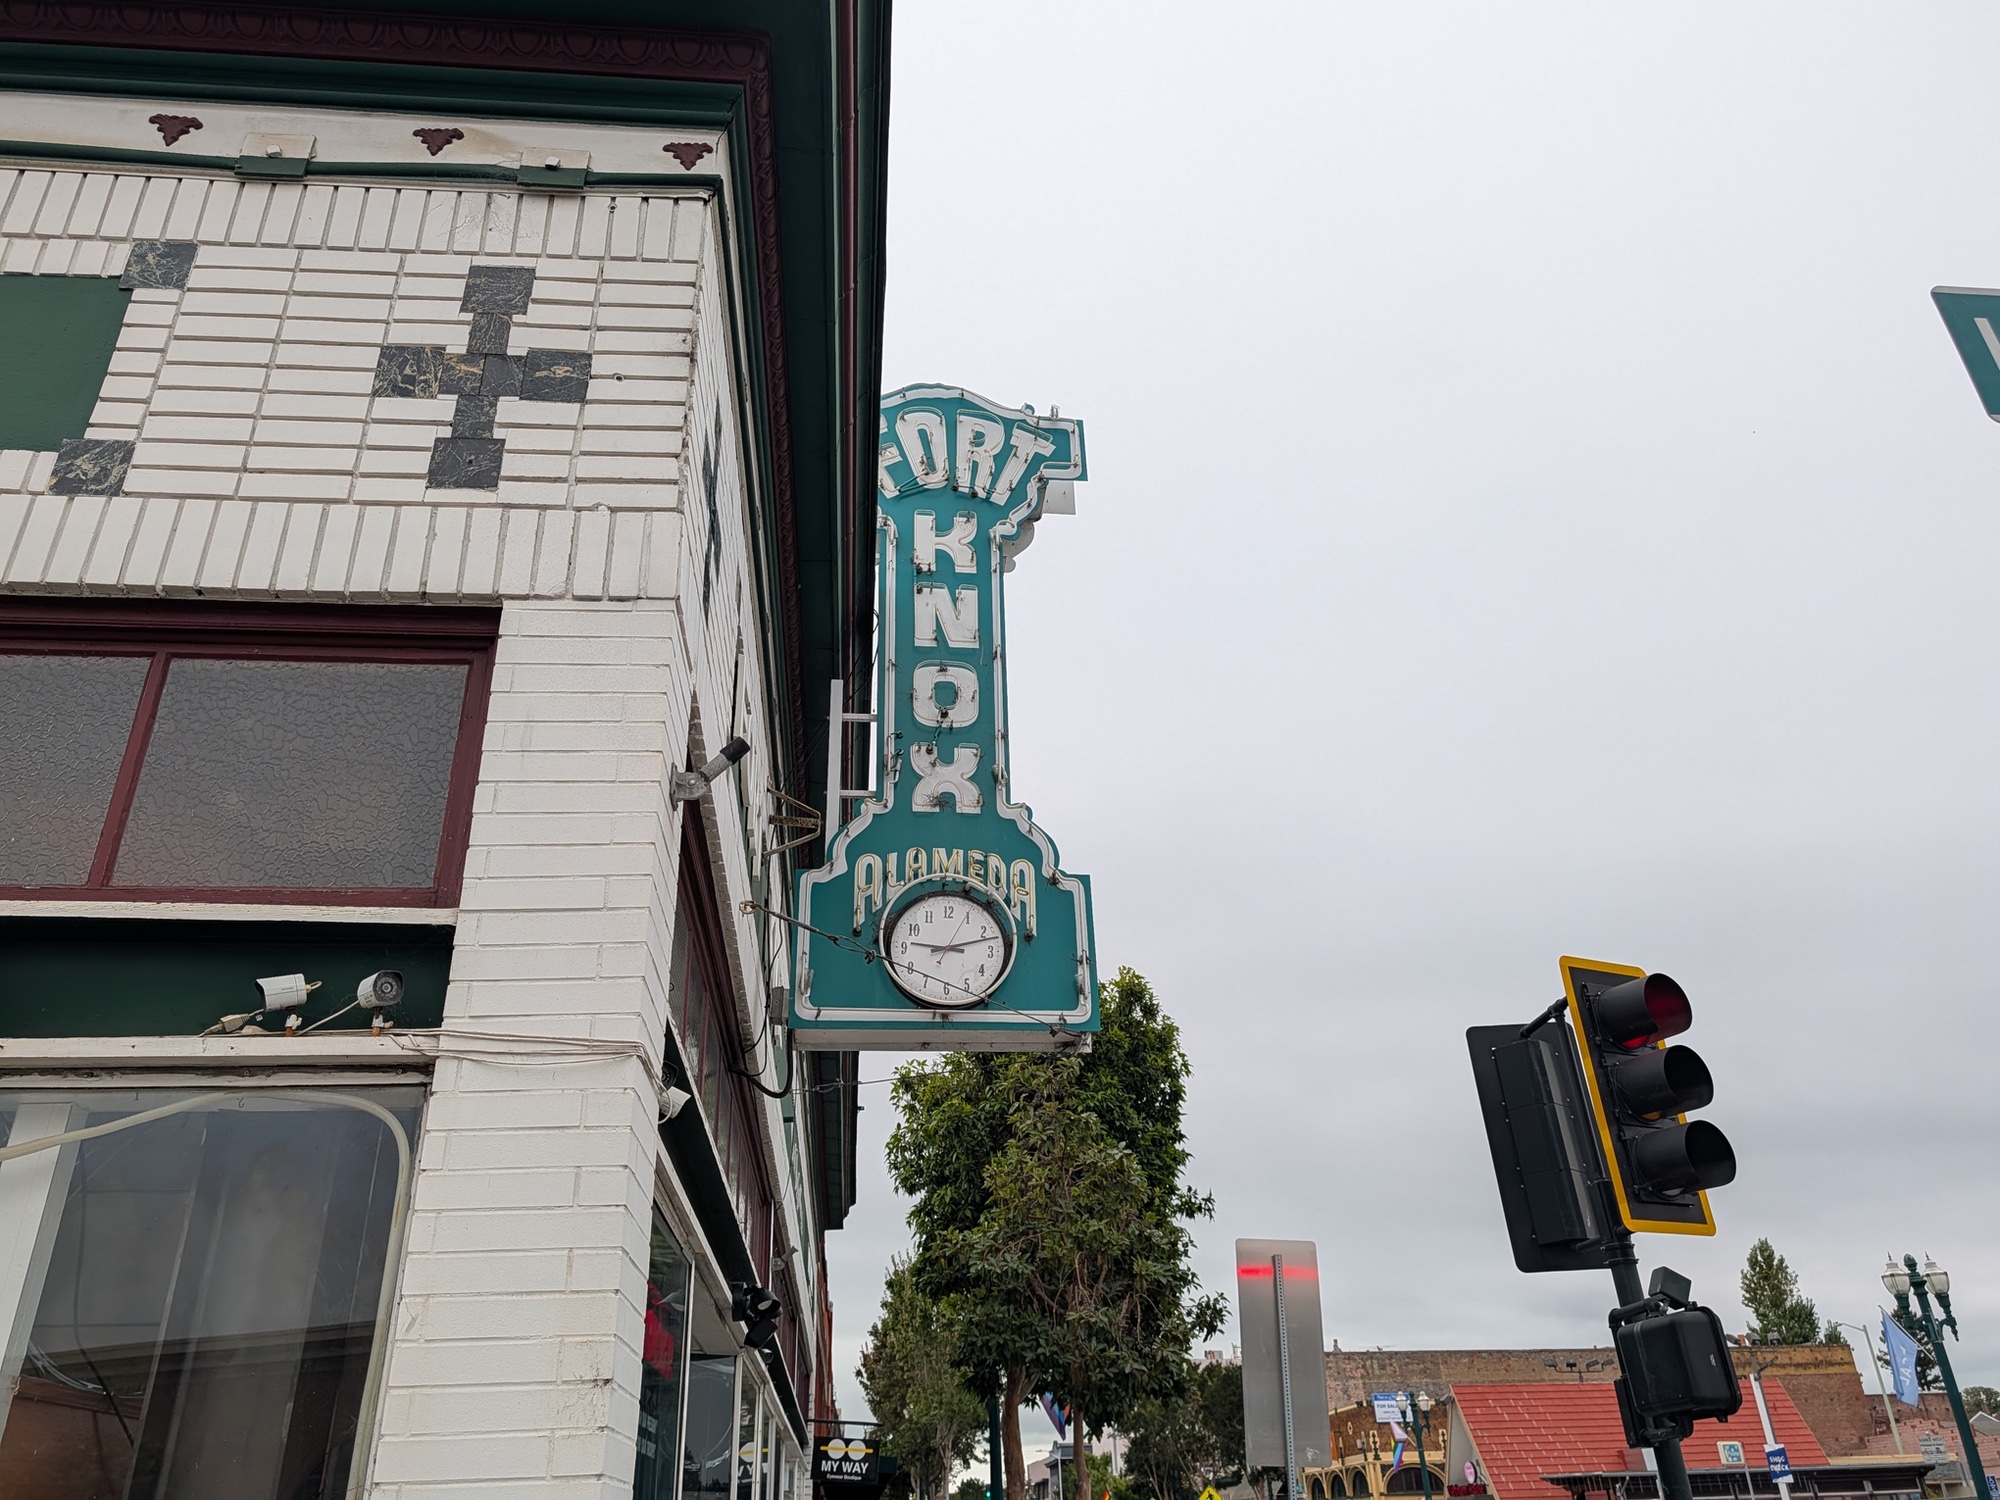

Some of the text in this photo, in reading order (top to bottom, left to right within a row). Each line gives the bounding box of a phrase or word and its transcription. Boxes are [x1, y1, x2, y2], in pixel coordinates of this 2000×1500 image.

[910, 509, 982, 814] KNOX
[853, 847, 1037, 936] ALAMEDA
[924, 911, 933, 924] 11
[943, 906, 954, 919] 12
[965, 911, 971, 925] 1
[908, 924, 920, 937] 10
[980, 926, 987, 939] 2
[901, 942, 908, 955] 9
[987, 945, 994, 959] 3
[907, 961, 914, 975] 8
[978, 964, 985, 977] 4
[922, 975, 929, 989] 7
[943, 982, 950, 996] 6
[964, 978, 970, 992] 5
[1769, 1455, 1786, 1463] SMOG
[821, 1460, 869, 1474] MY WAY
